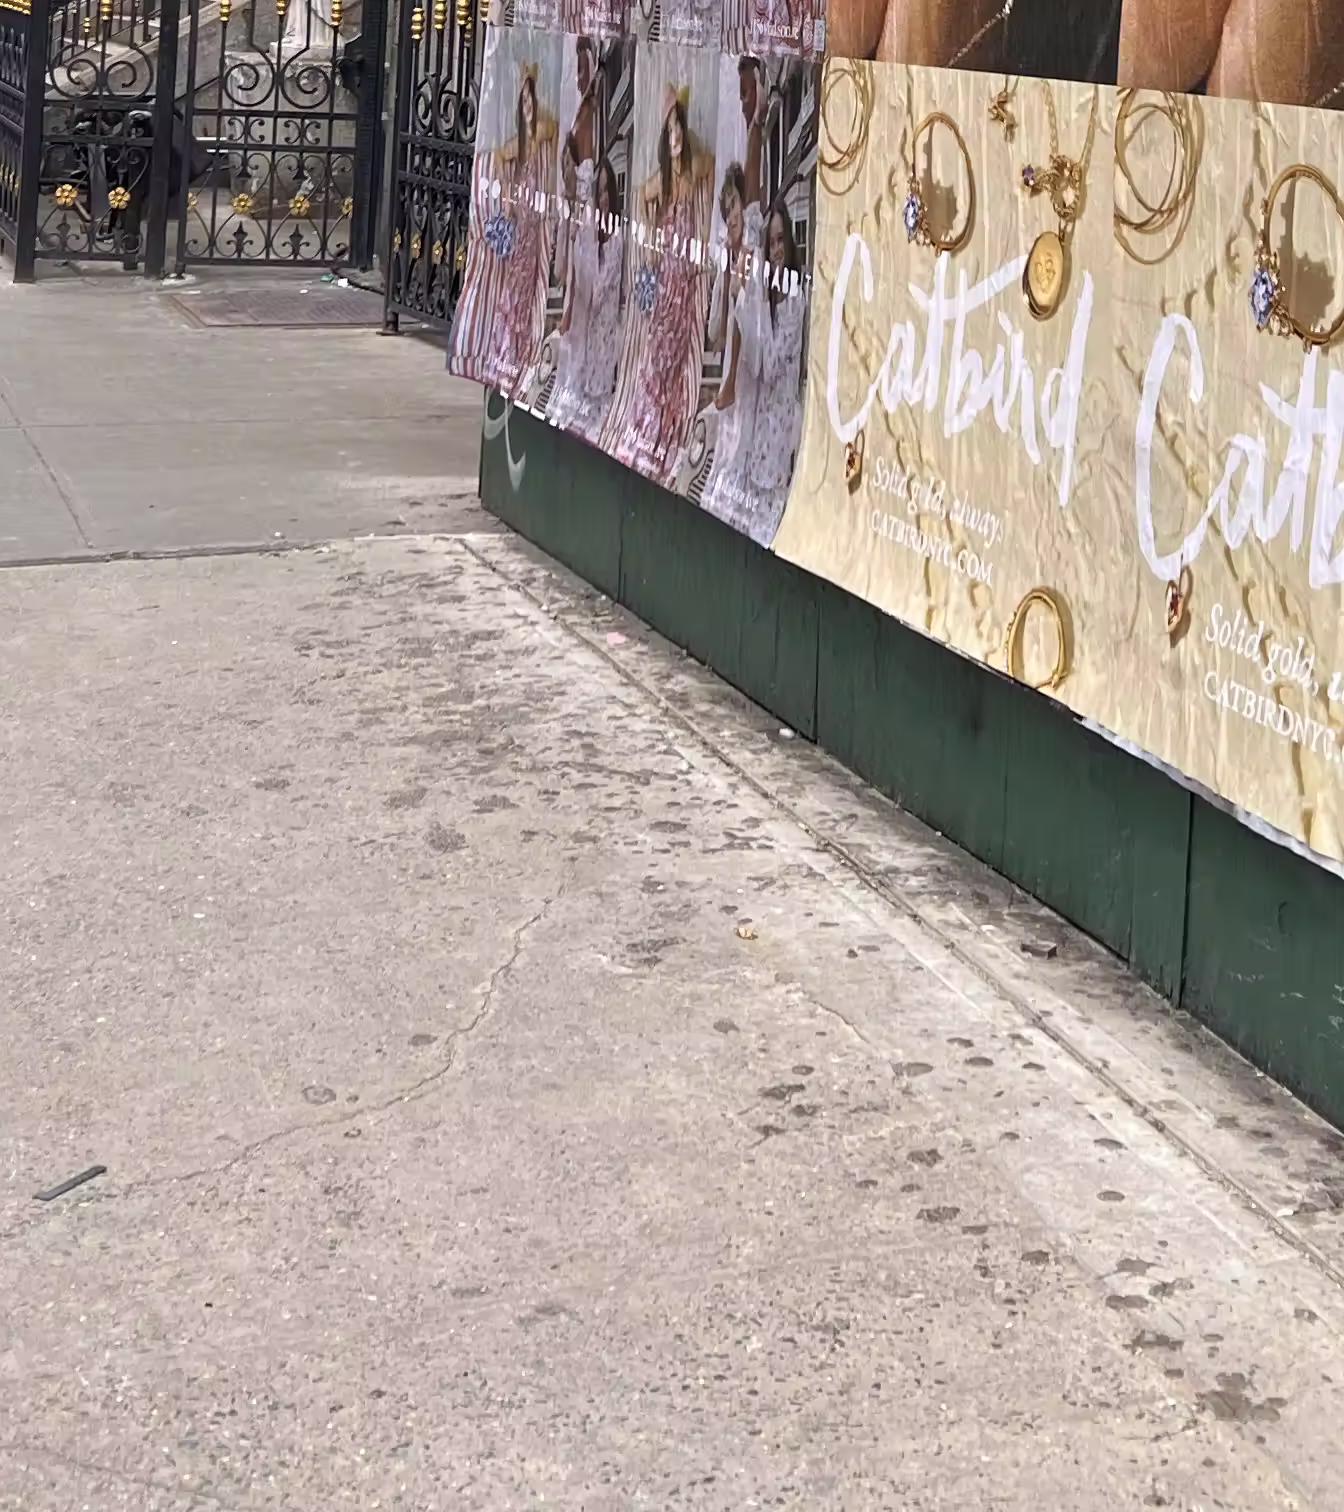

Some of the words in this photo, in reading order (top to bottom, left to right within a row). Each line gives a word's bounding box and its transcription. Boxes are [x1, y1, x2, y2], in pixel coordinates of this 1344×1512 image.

[825, 232, 1094, 506] Catbird
[873, 456, 910, 498] Solid
[1205, 603, 1264, 662] Solid
[1261, 636, 1320, 697] gold,
